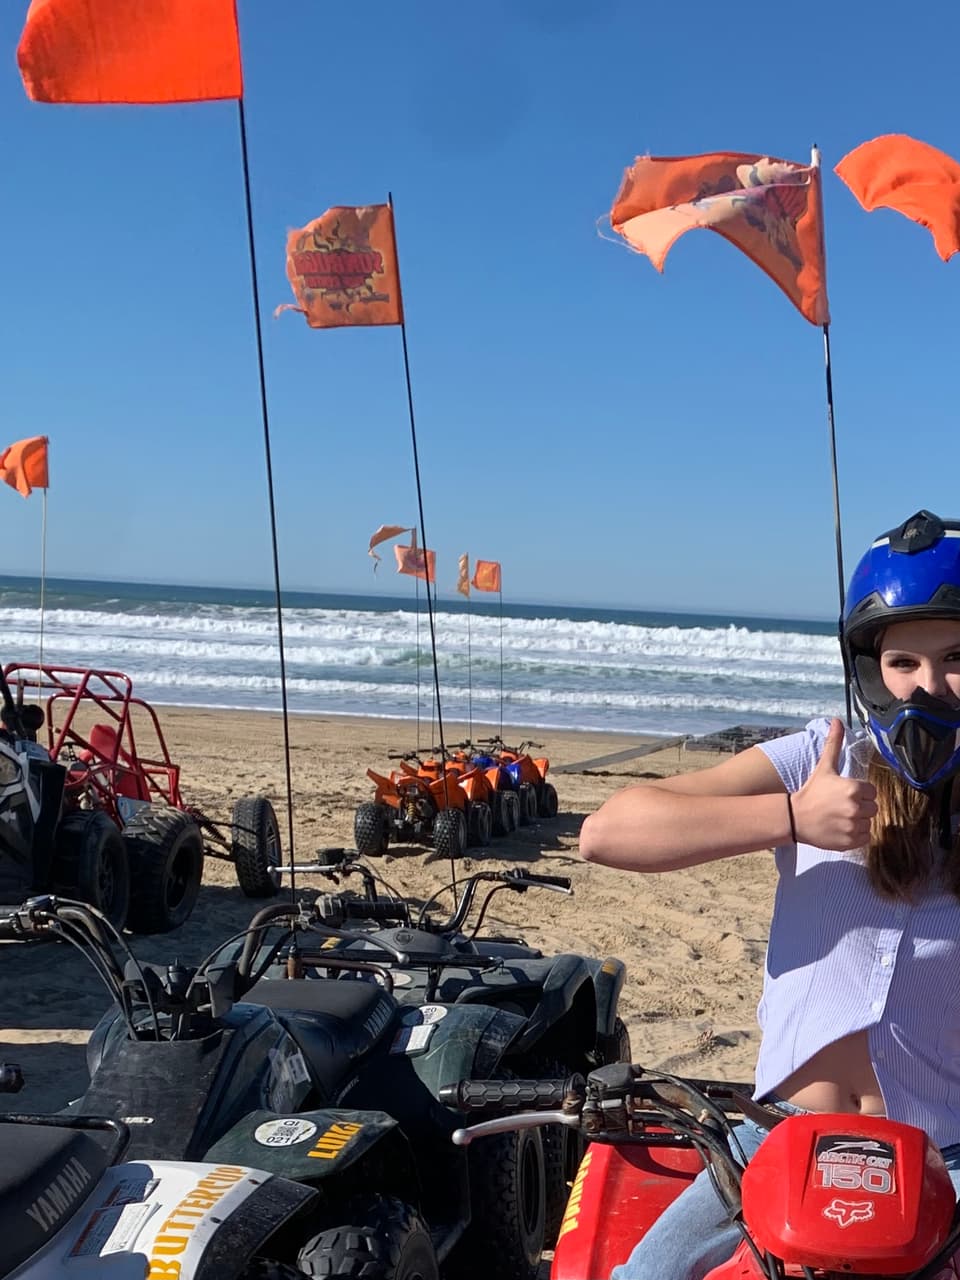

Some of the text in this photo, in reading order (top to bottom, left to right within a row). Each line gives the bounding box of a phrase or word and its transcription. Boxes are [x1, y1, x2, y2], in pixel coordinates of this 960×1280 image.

[817, 1151, 893, 1169] ARCTIC CAT
[26, 1156, 92, 1232] YAMAHA
[817, 1162, 892, 1194] 150
